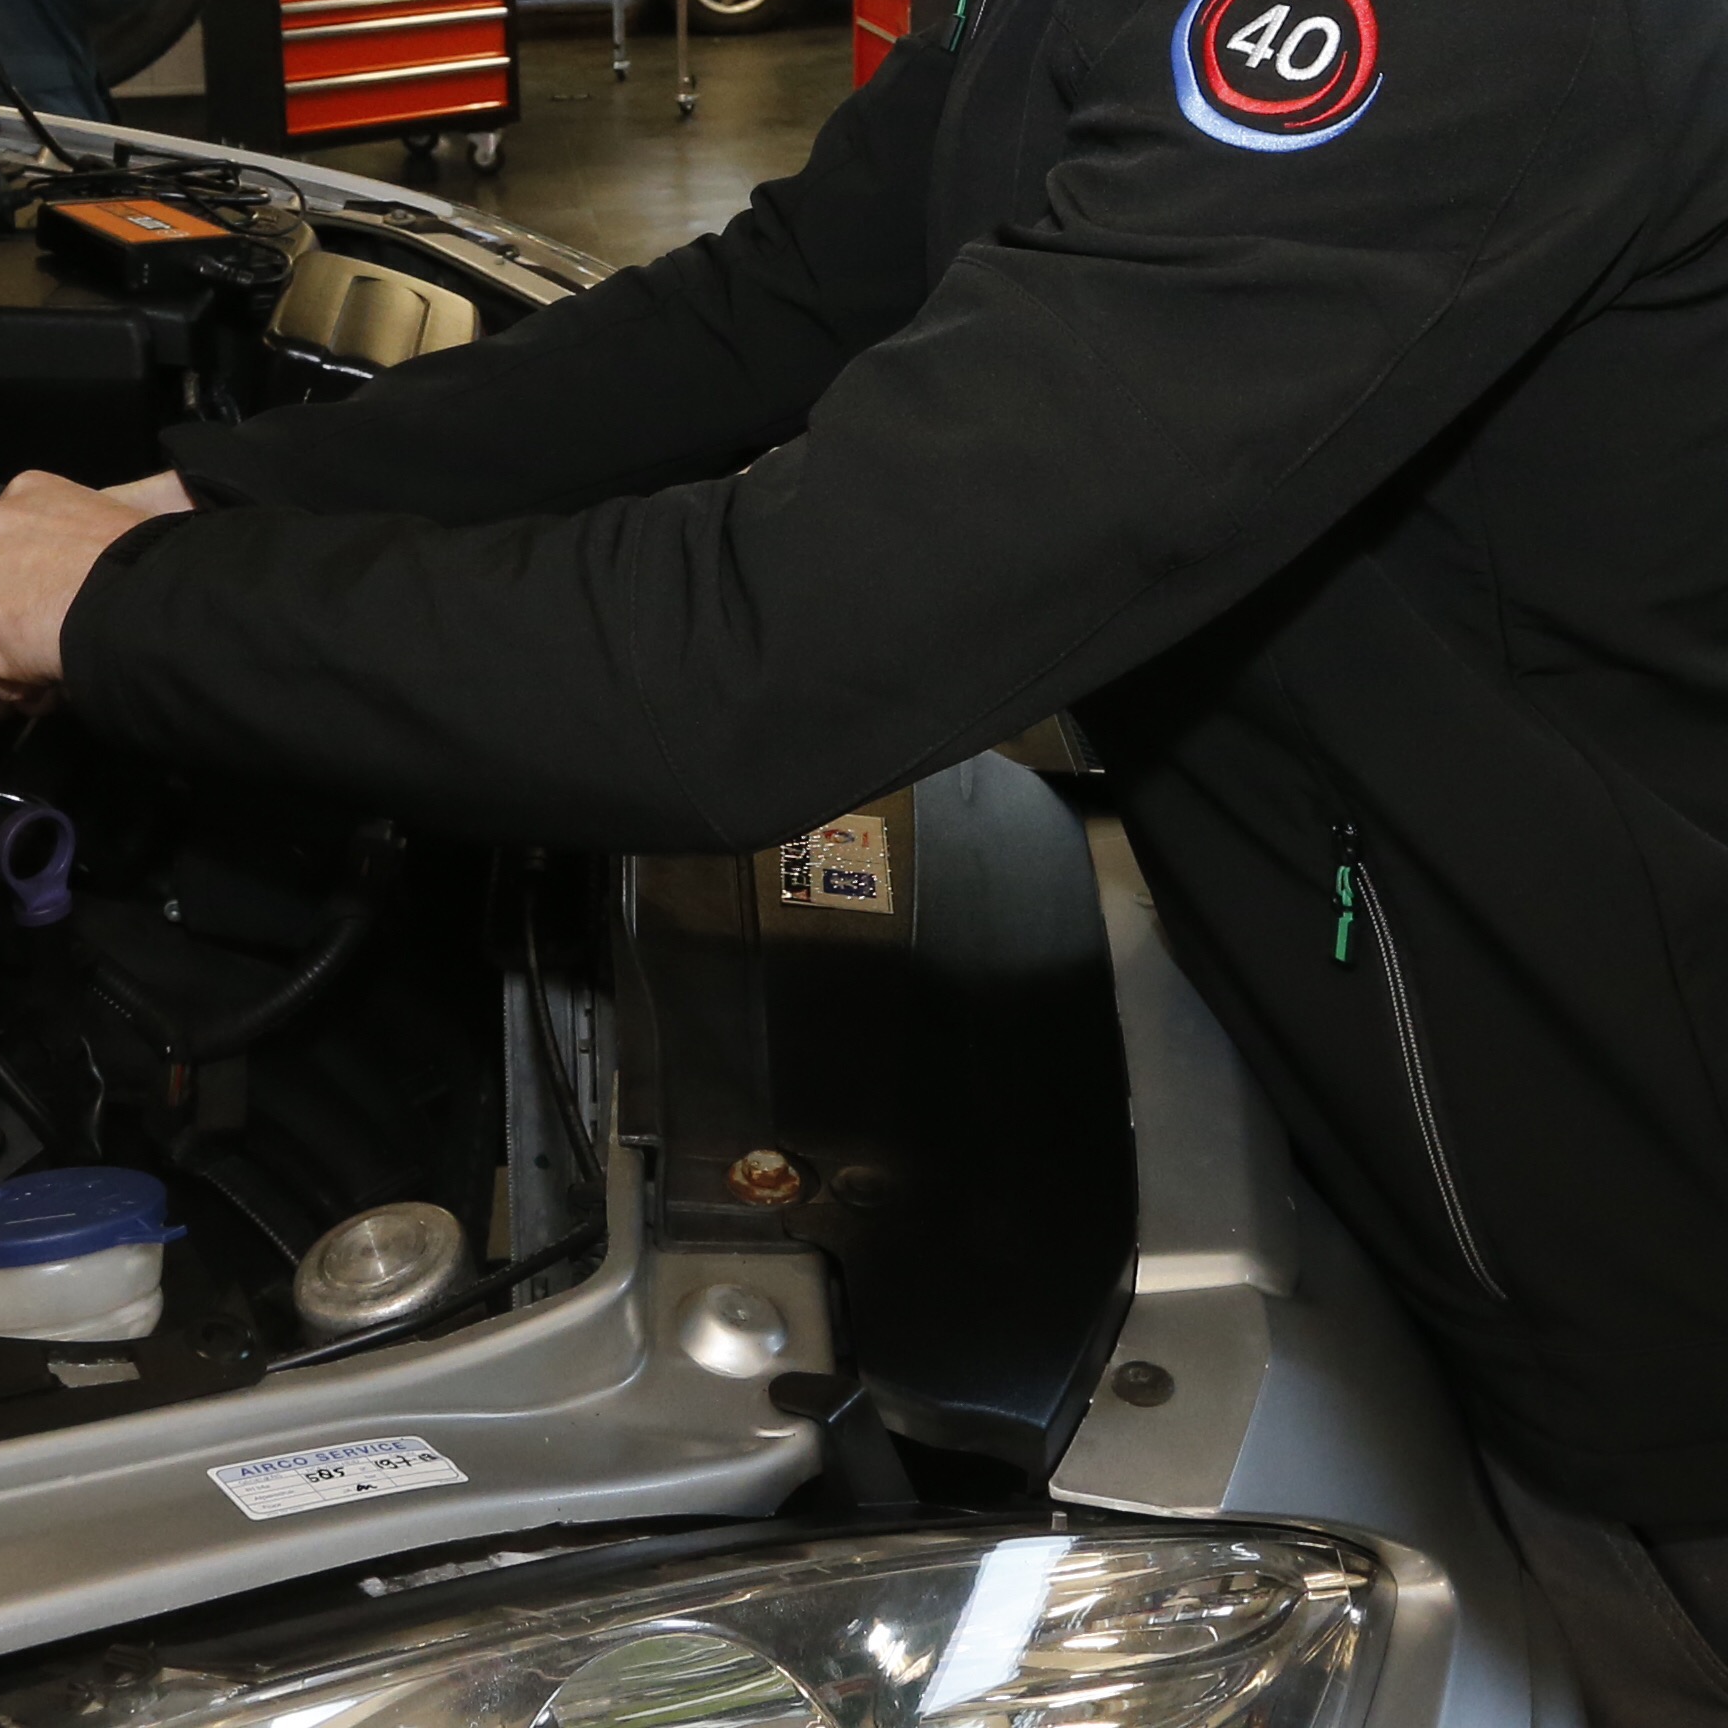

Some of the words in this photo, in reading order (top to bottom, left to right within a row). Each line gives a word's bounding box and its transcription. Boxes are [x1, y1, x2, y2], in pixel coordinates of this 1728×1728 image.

[1226, 3, 1341, 81] 40
[240, 1457, 308, 1477] AIRCO
[315, 1441, 407, 1462] SERVICE
